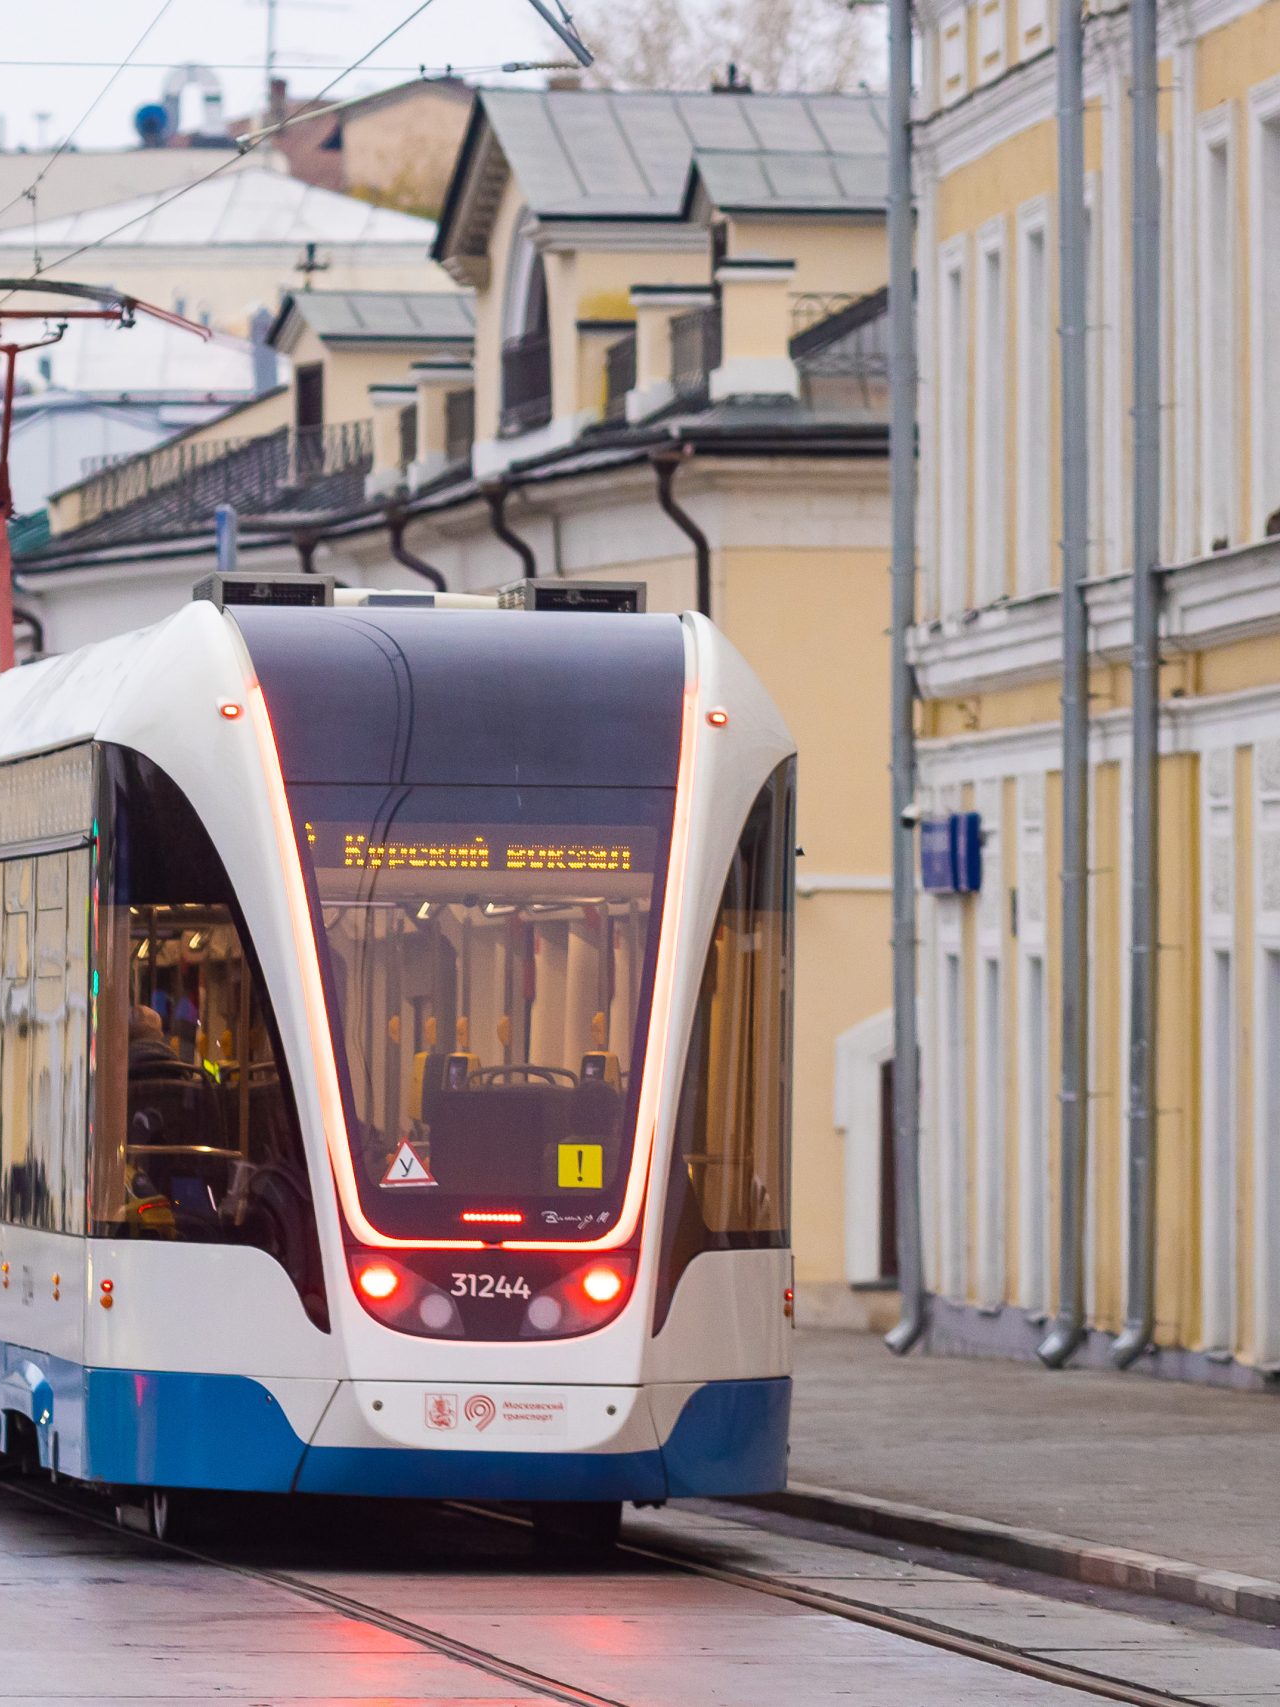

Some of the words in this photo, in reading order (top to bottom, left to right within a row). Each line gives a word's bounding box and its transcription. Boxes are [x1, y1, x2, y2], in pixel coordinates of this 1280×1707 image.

[450, 1273, 532, 1299] 31244
[502, 1401, 564, 1410] Московский
[503, 1413, 553, 1422] транспорт
